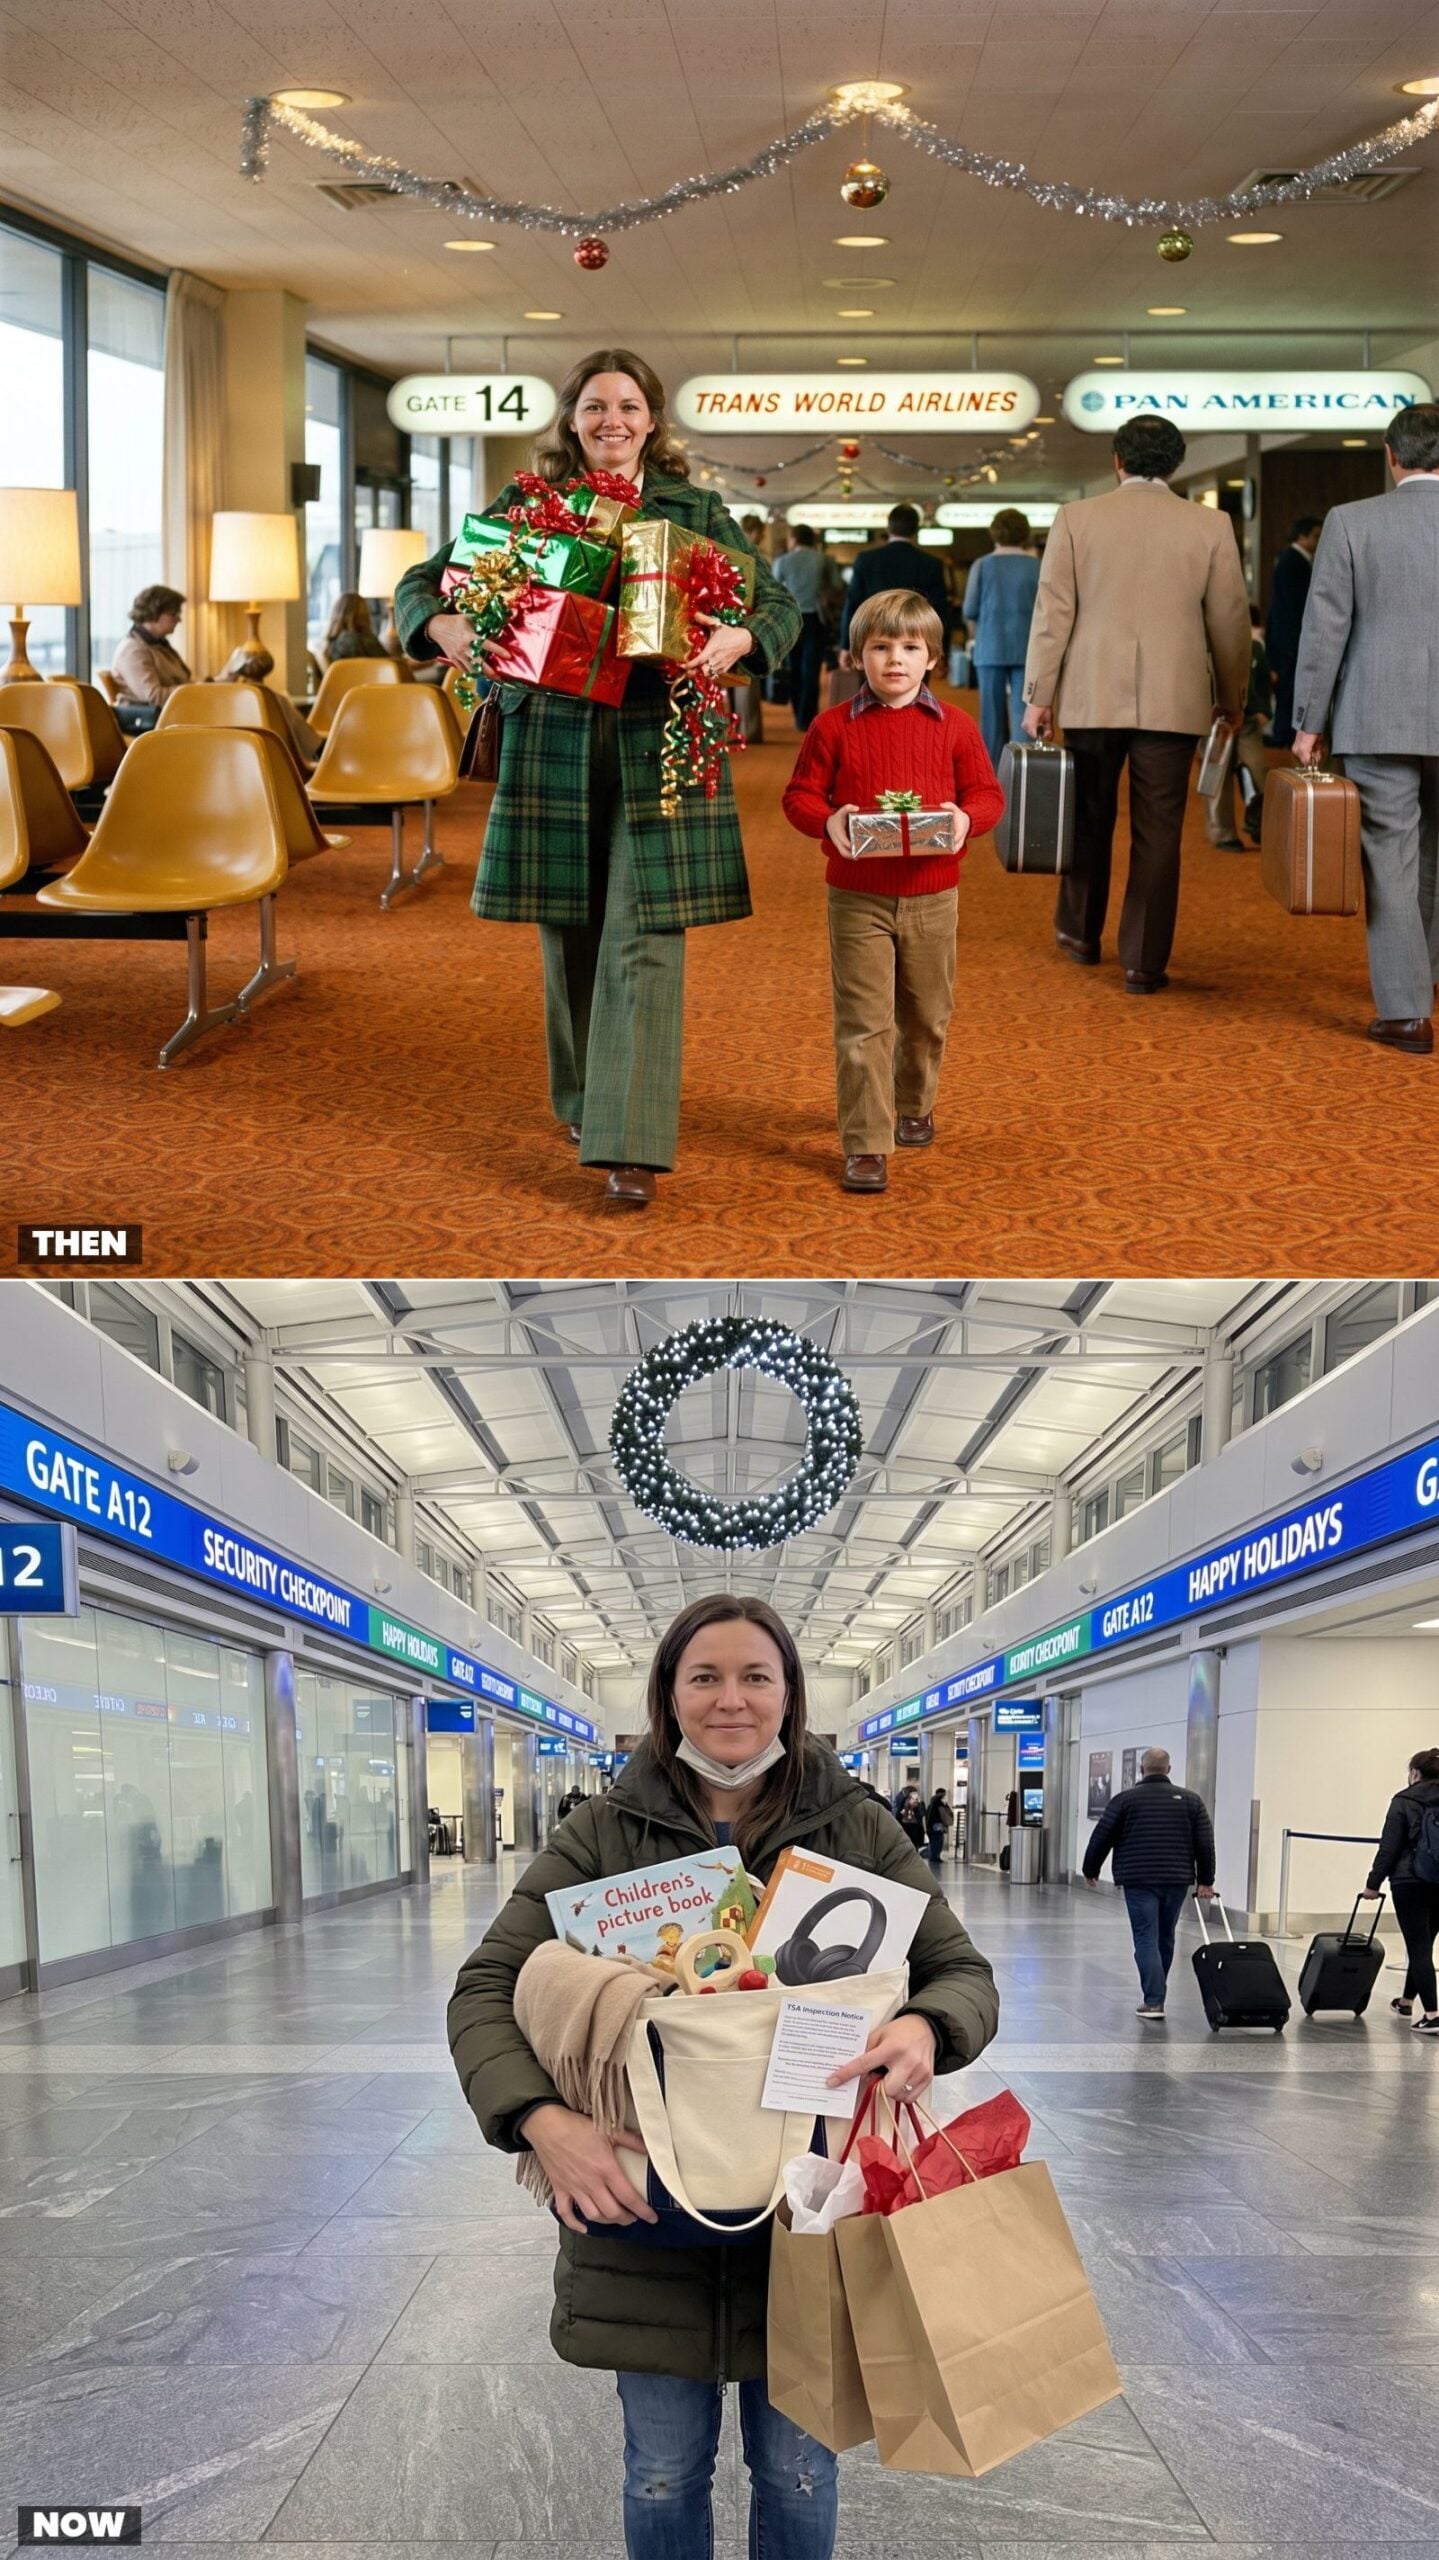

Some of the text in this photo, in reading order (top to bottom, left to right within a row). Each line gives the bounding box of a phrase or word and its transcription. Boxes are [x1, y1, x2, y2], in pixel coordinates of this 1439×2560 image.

[406, 385, 529, 421] GATE 14
[696, 391, 1017, 413] TRANS WORLD AIRLINES
[1114, 393, 1417, 409] PAN AMERICAN
[26, 1440, 152, 1538] GATE A12
[1416, 1456, 1439, 1506] G
[1188, 1502, 1343, 1603] HAPPY HOLIDAYS
[203, 1529, 351, 1628] SECURITY CHECKPOINT
[1103, 1591, 1154, 1638] GATE A12
[382, 1620, 439, 1668] HAPPY HOLIDAYS
[597, 1886, 714, 1938] picture book
[604, 1872, 695, 1908] Children's
[787, 2003, 864, 2021] TSA Inspection Notice
